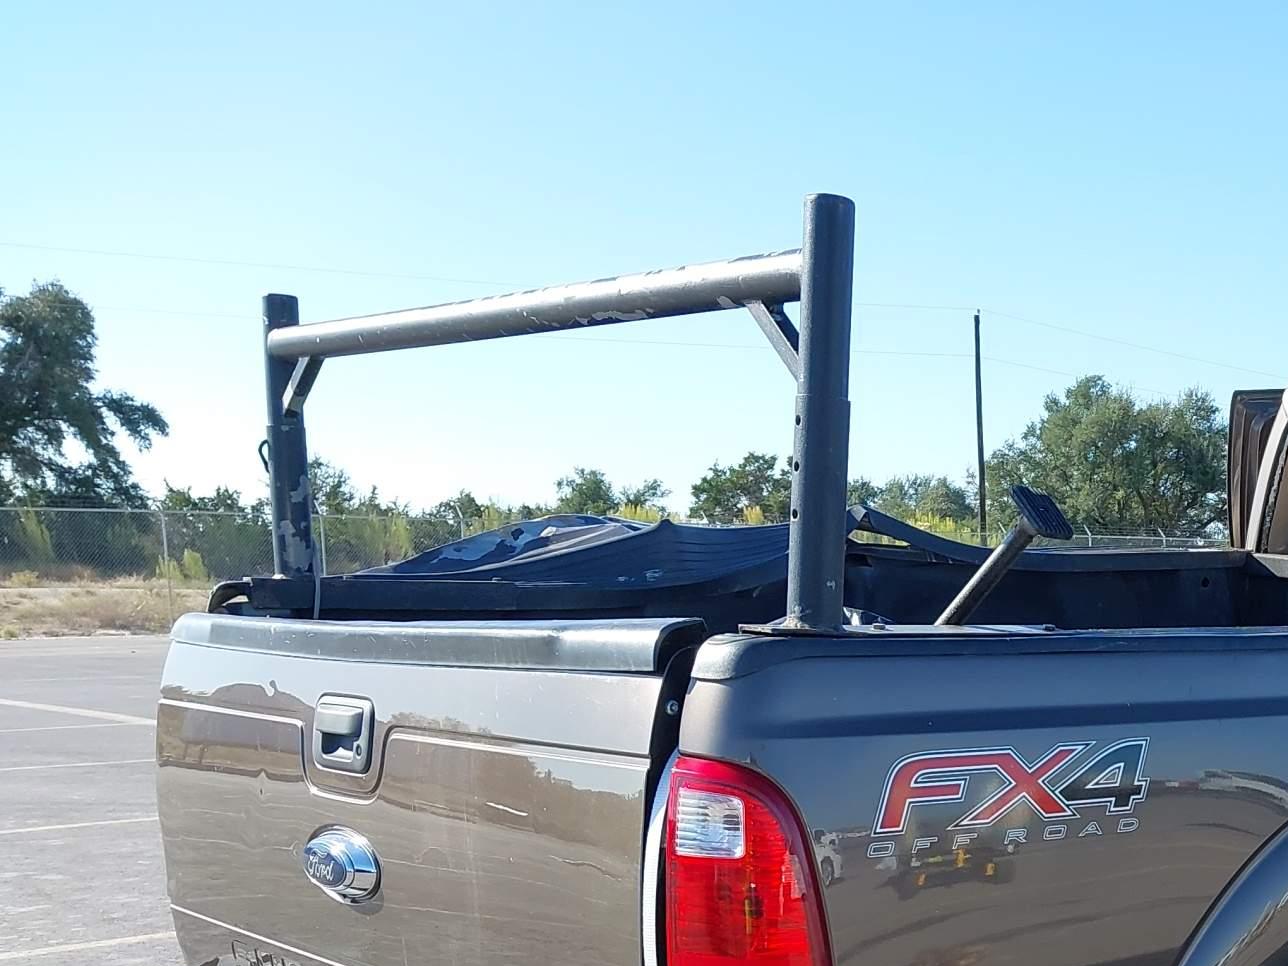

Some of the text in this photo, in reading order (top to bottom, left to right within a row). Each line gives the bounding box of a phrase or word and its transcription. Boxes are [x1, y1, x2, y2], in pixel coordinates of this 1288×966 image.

[870, 736, 1151, 838] FX4
[866, 816, 1141, 859] OFF ROAD
[307, 848, 335, 881] Ford
